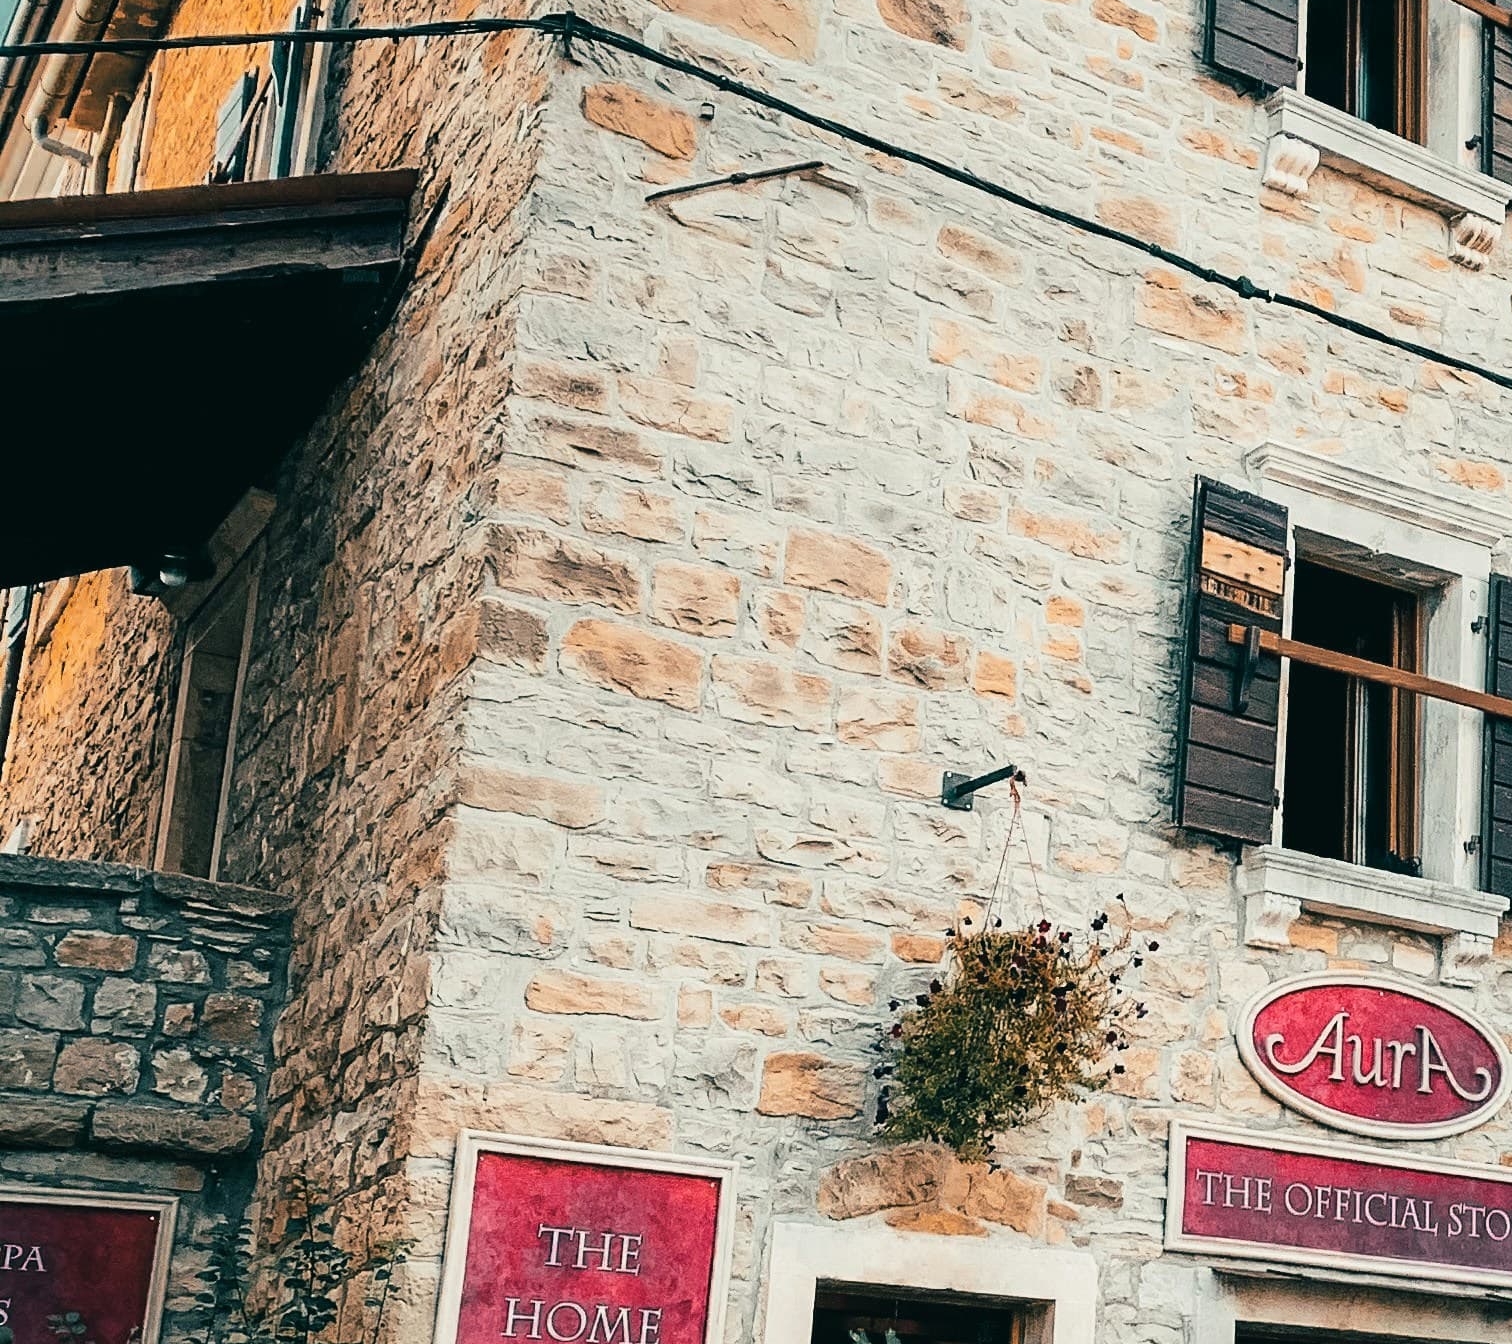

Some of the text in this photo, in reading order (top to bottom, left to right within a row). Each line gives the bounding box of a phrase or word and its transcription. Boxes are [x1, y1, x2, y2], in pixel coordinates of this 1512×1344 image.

[1196, 1168, 1273, 1215] THE
[1285, 1183, 1438, 1237] OFFICIAL
[0, 1243, 47, 1272] PA
[538, 1223, 643, 1276] THE
